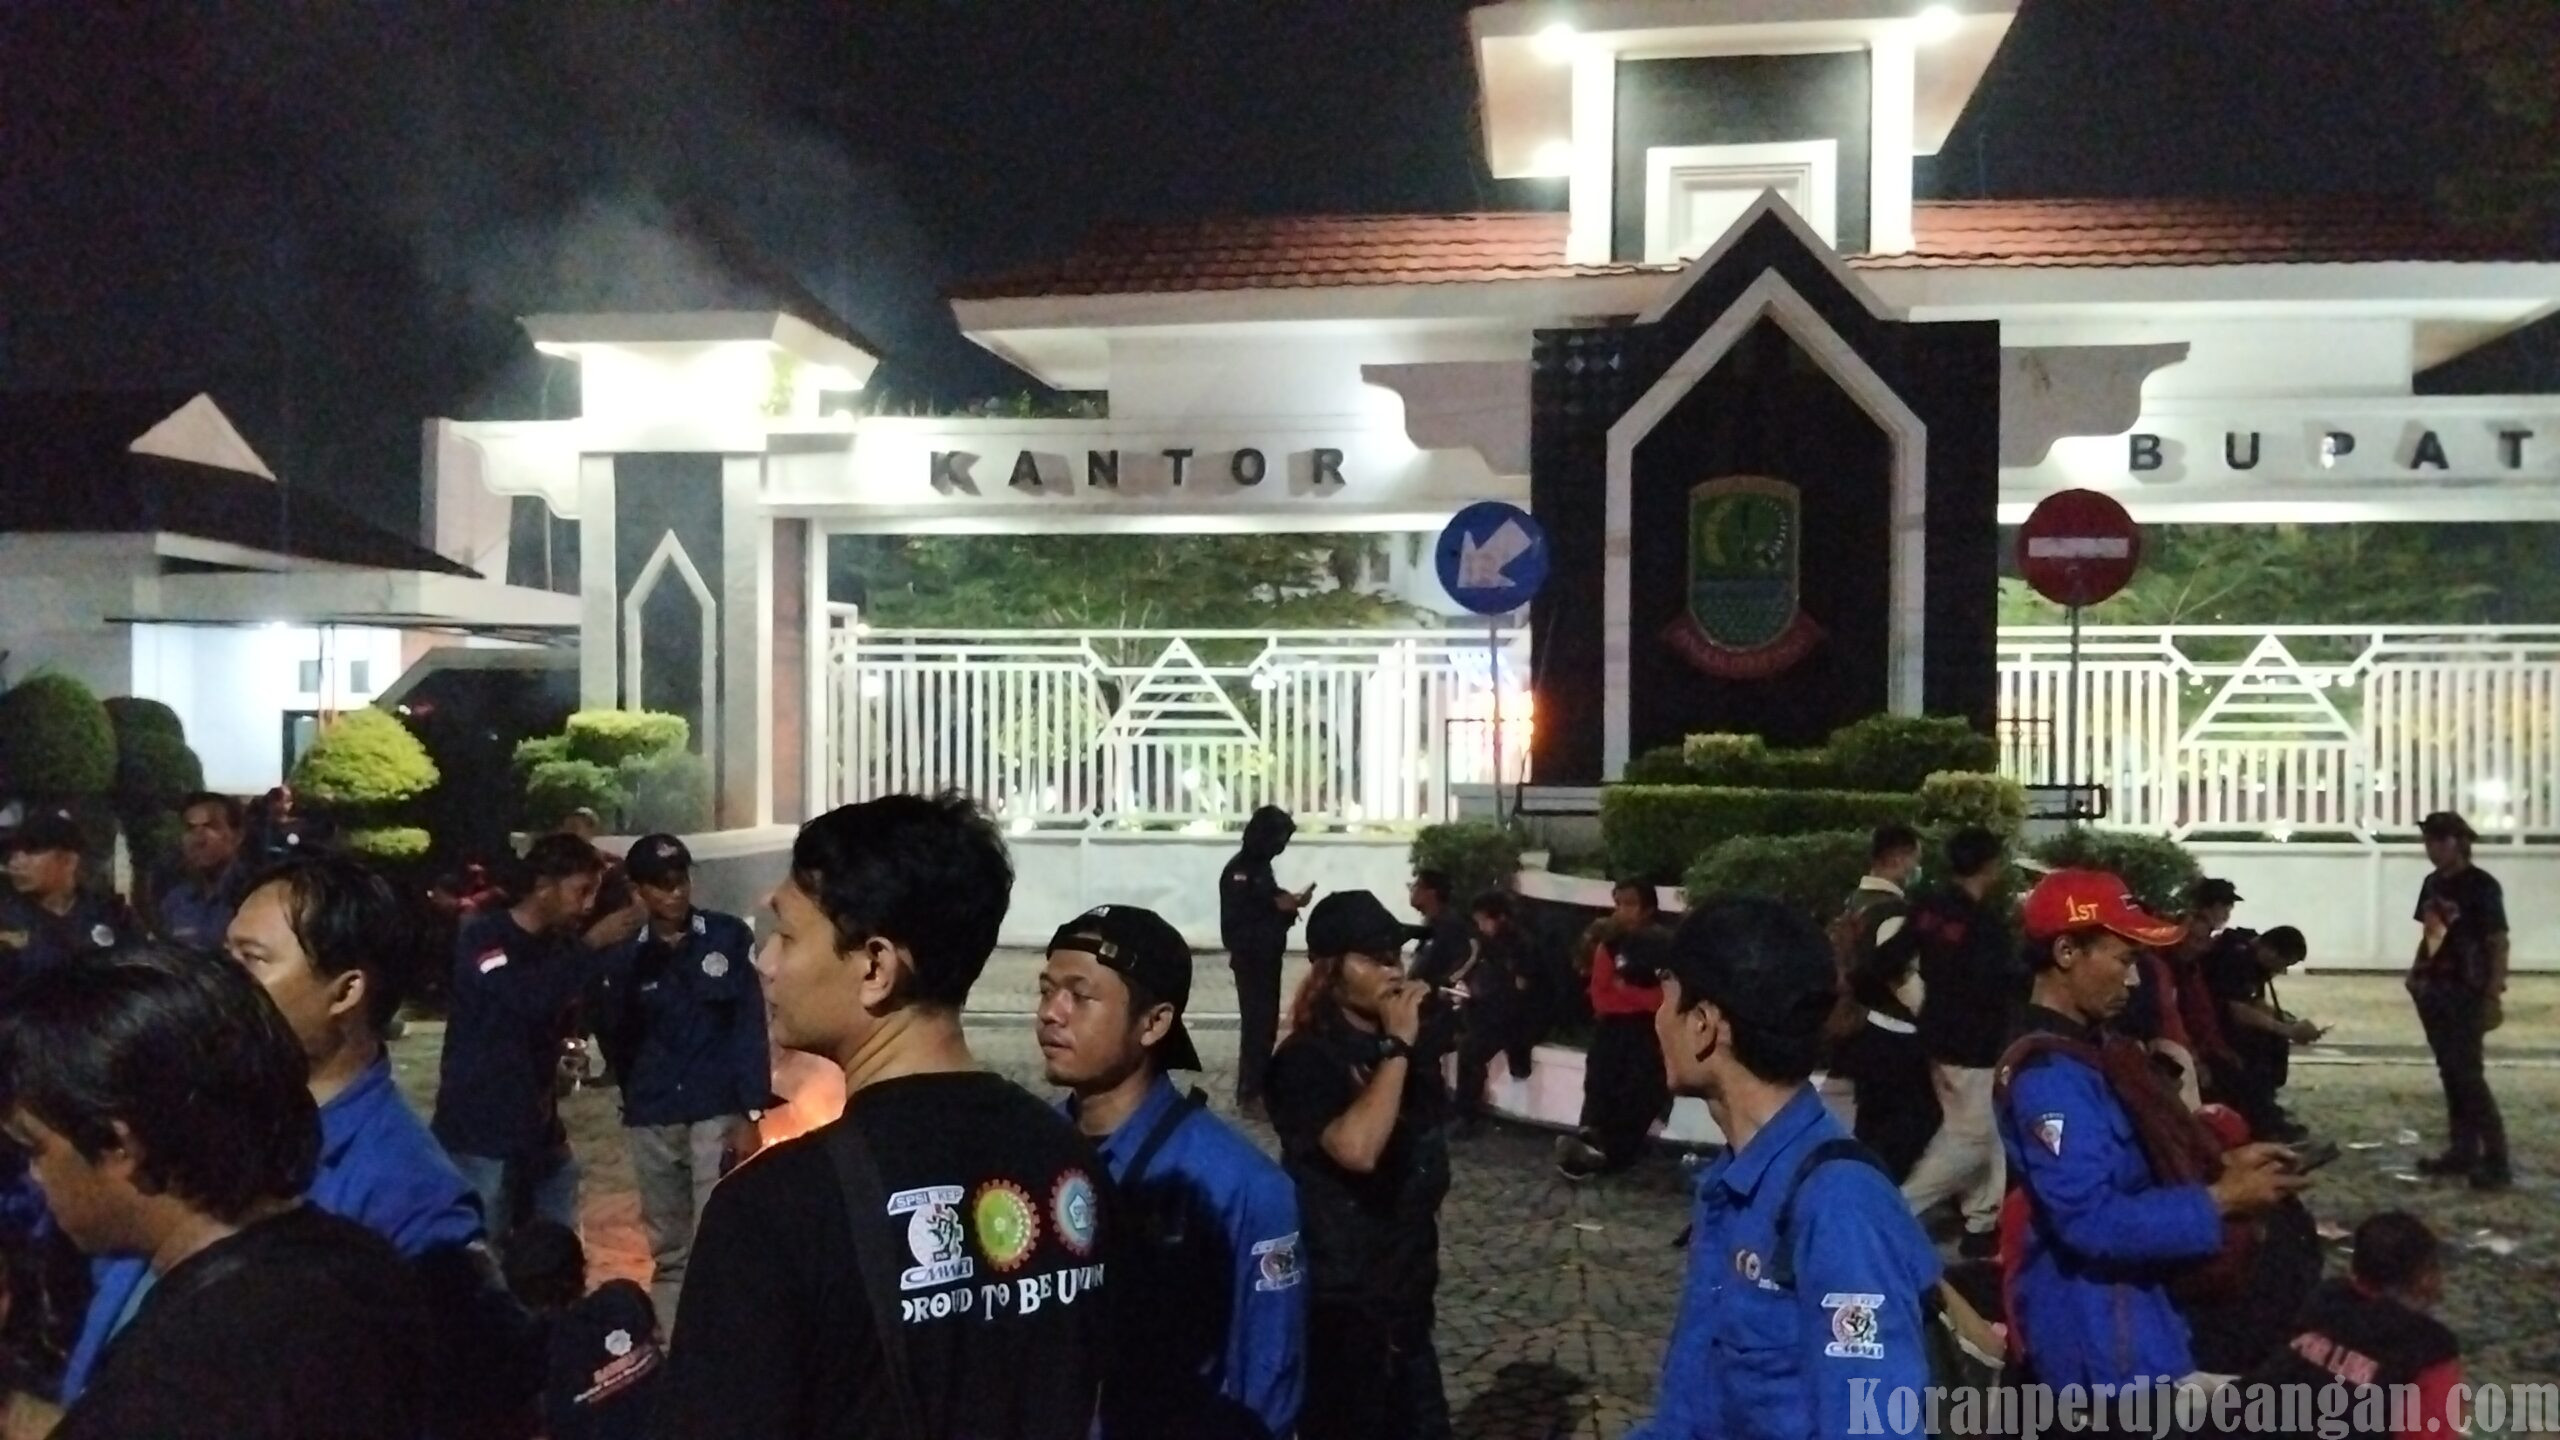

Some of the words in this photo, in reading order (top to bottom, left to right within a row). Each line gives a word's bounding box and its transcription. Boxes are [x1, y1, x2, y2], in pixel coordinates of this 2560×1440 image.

[930, 448, 1346, 487] KANTOR
[2129, 430, 2534, 473] BUPAT
[2065, 894, 2099, 922] 1ST
[895, 1192, 930, 1209] SPSI
[1017, 1273, 1052, 1315] BE
